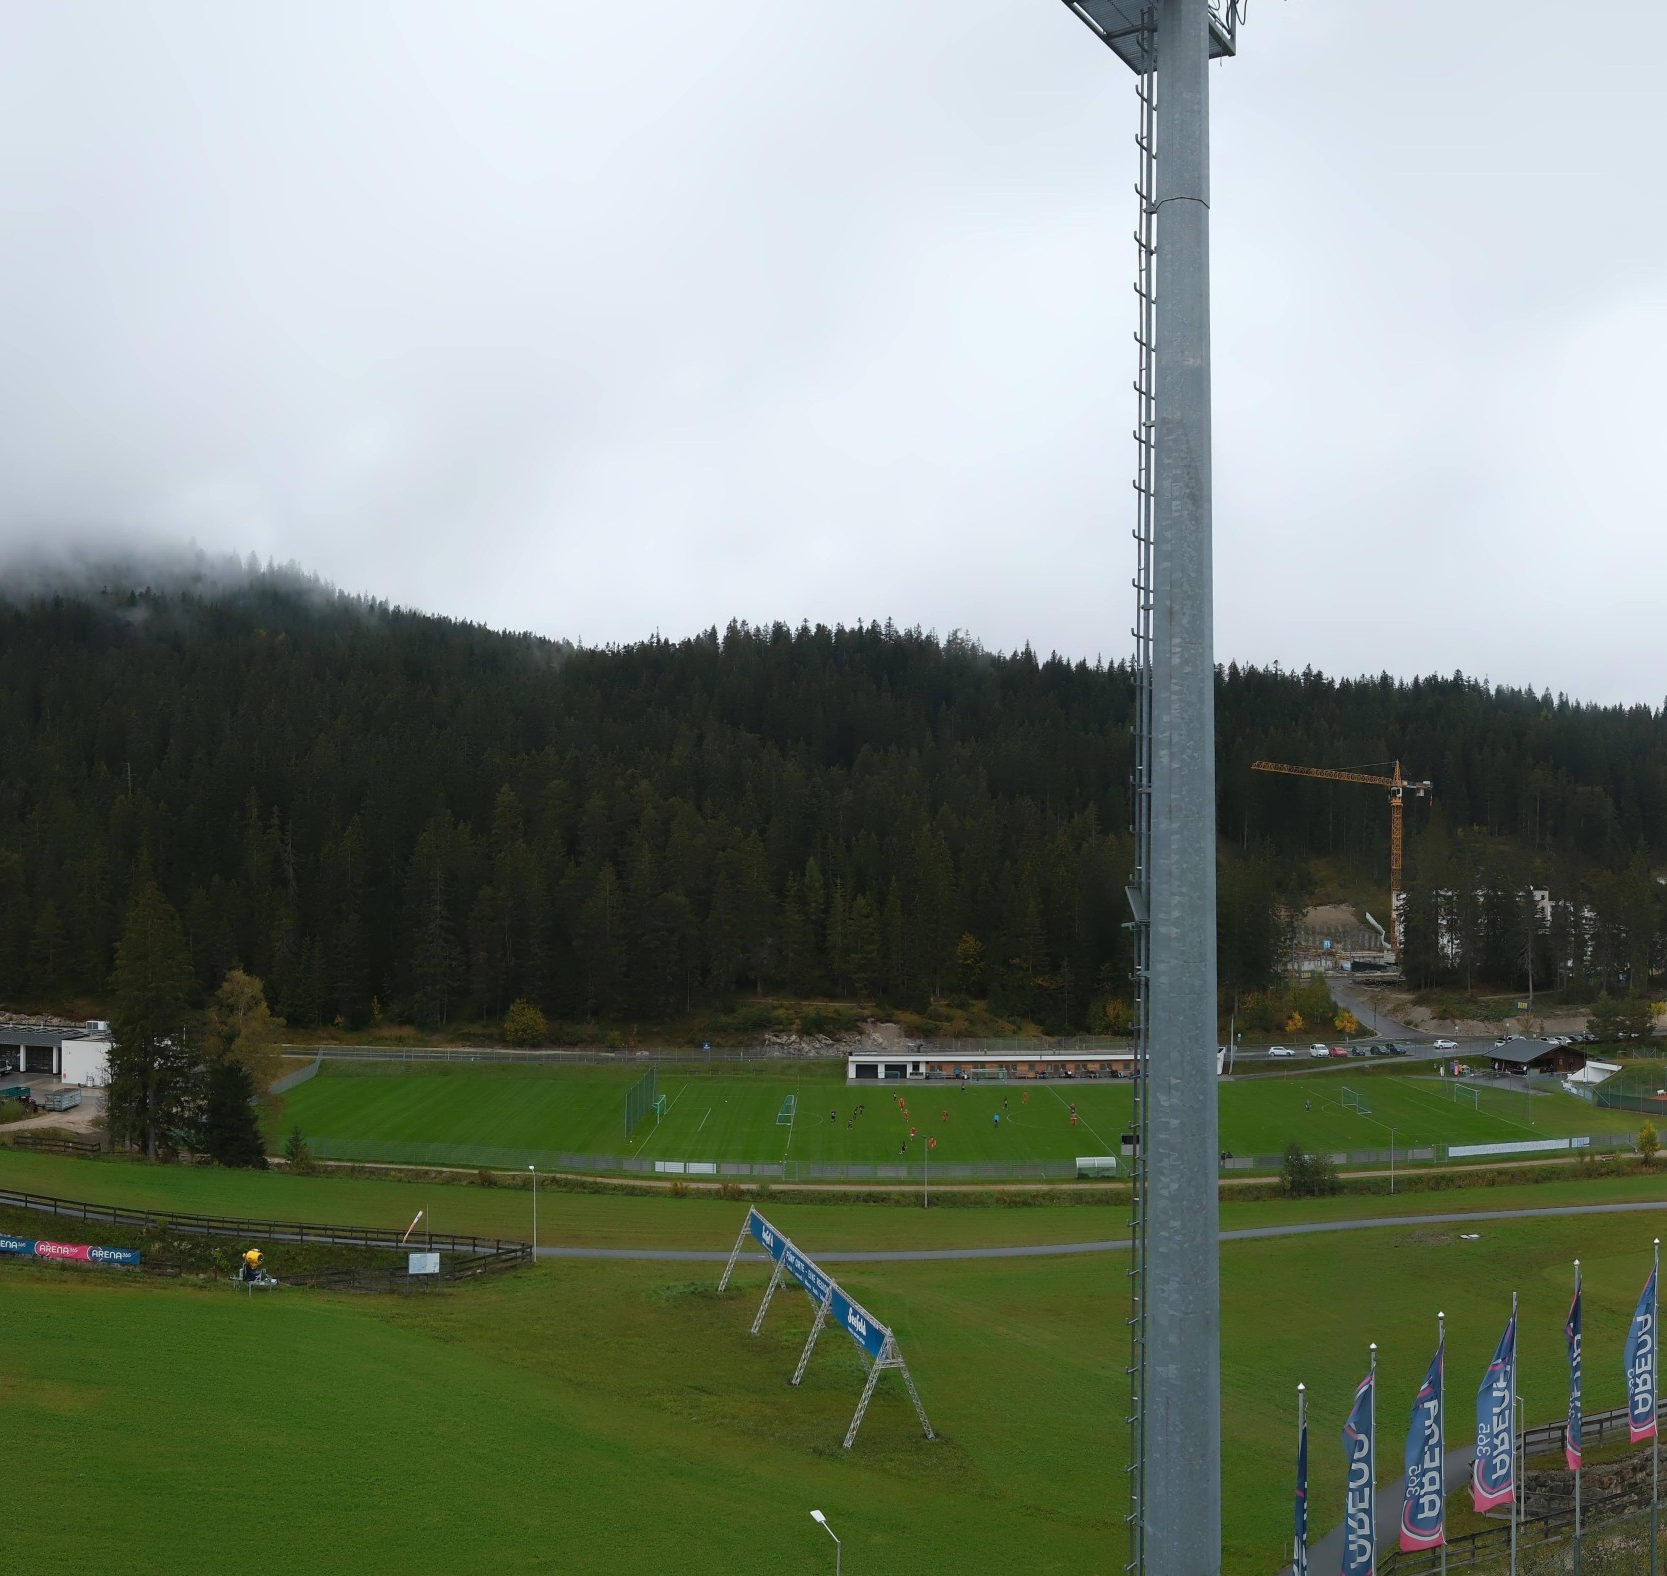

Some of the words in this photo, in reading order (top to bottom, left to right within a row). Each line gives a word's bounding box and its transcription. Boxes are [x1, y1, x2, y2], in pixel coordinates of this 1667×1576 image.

[39, 1244, 69, 1254] ARENA
[91, 1250, 122, 1259] ARENA
[847, 1306, 867, 1336] Seefeld
